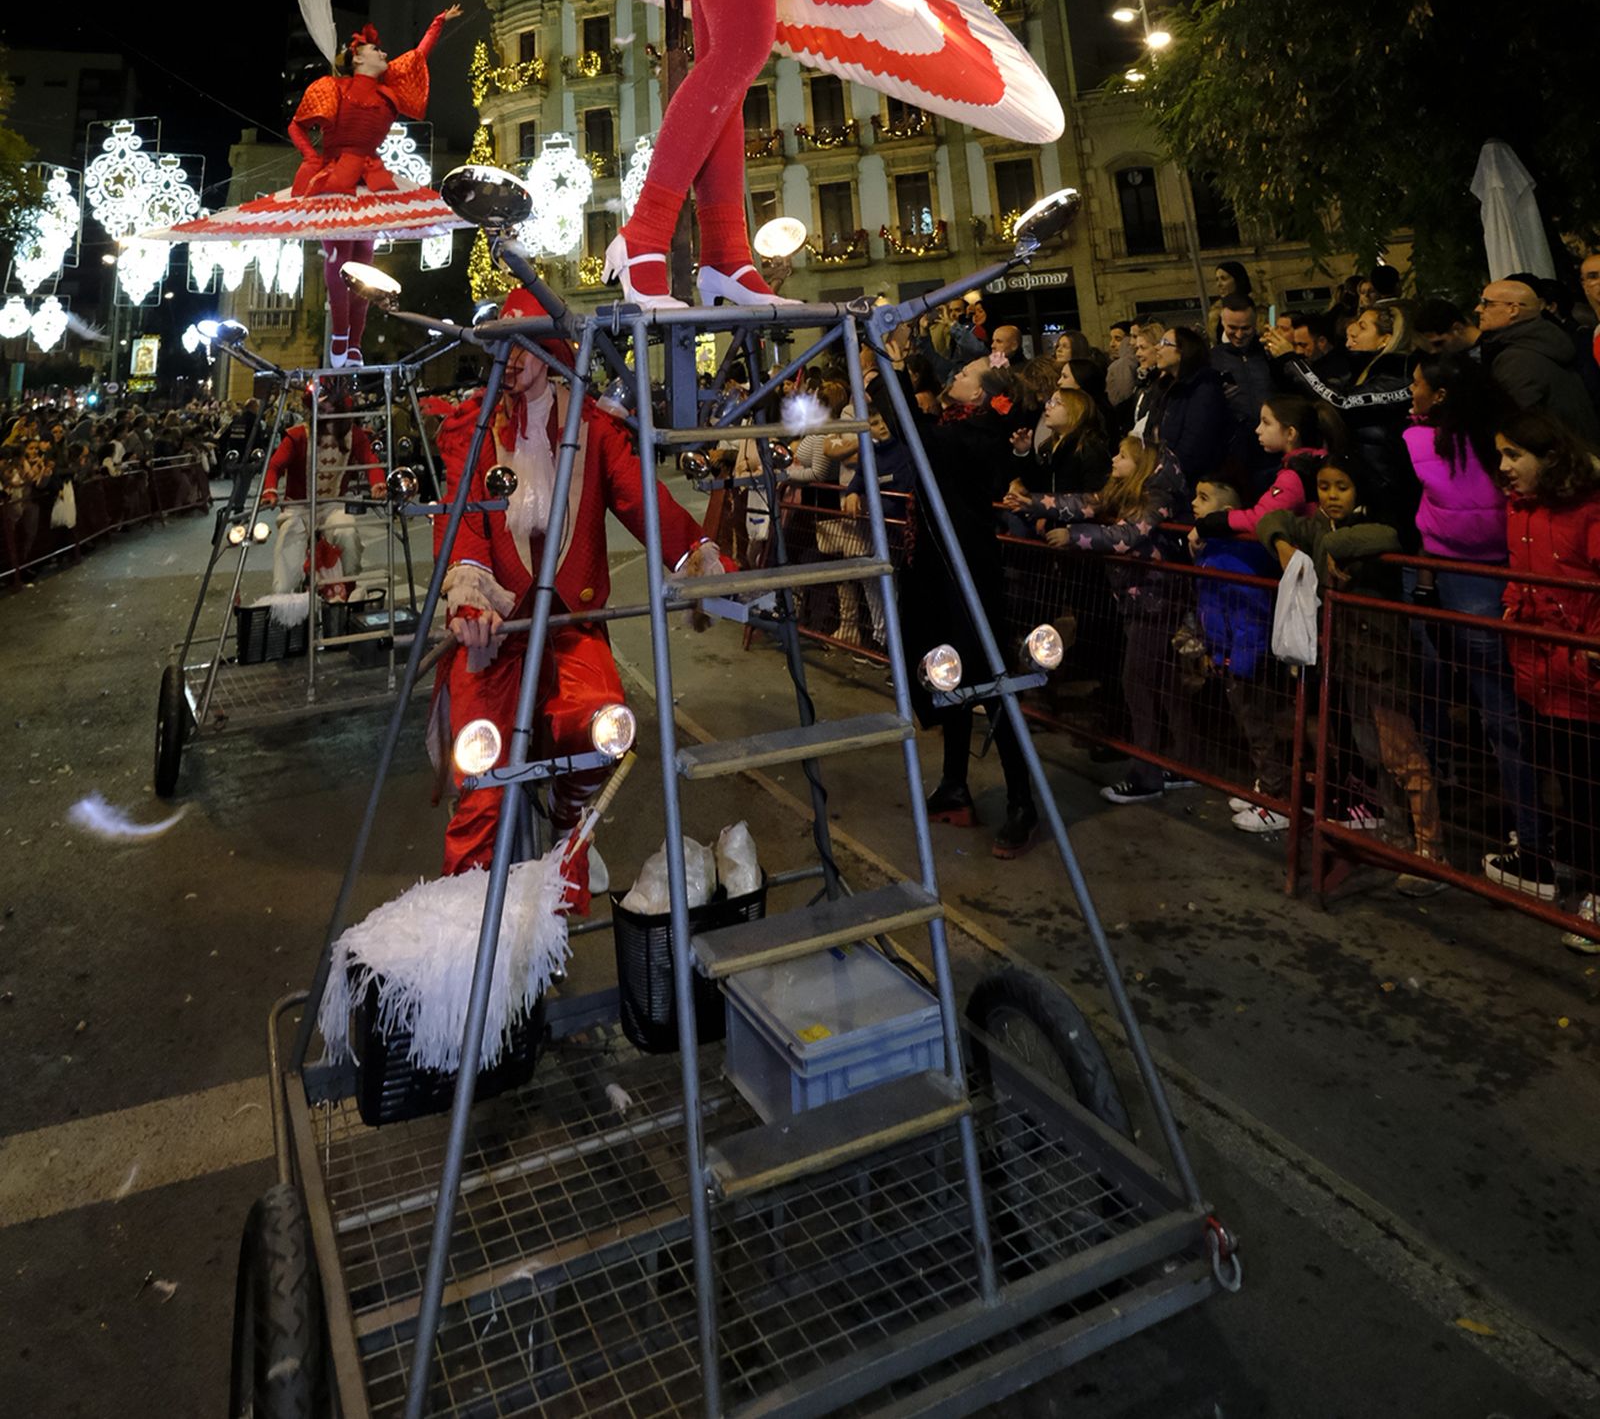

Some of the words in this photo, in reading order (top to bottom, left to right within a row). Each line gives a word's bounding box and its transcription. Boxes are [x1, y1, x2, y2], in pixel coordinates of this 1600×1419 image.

[1008, 272, 1069, 290] cajamar
[1304, 371, 1334, 401] MICHAEL
[1371, 389, 1410, 403] MICHAEL
